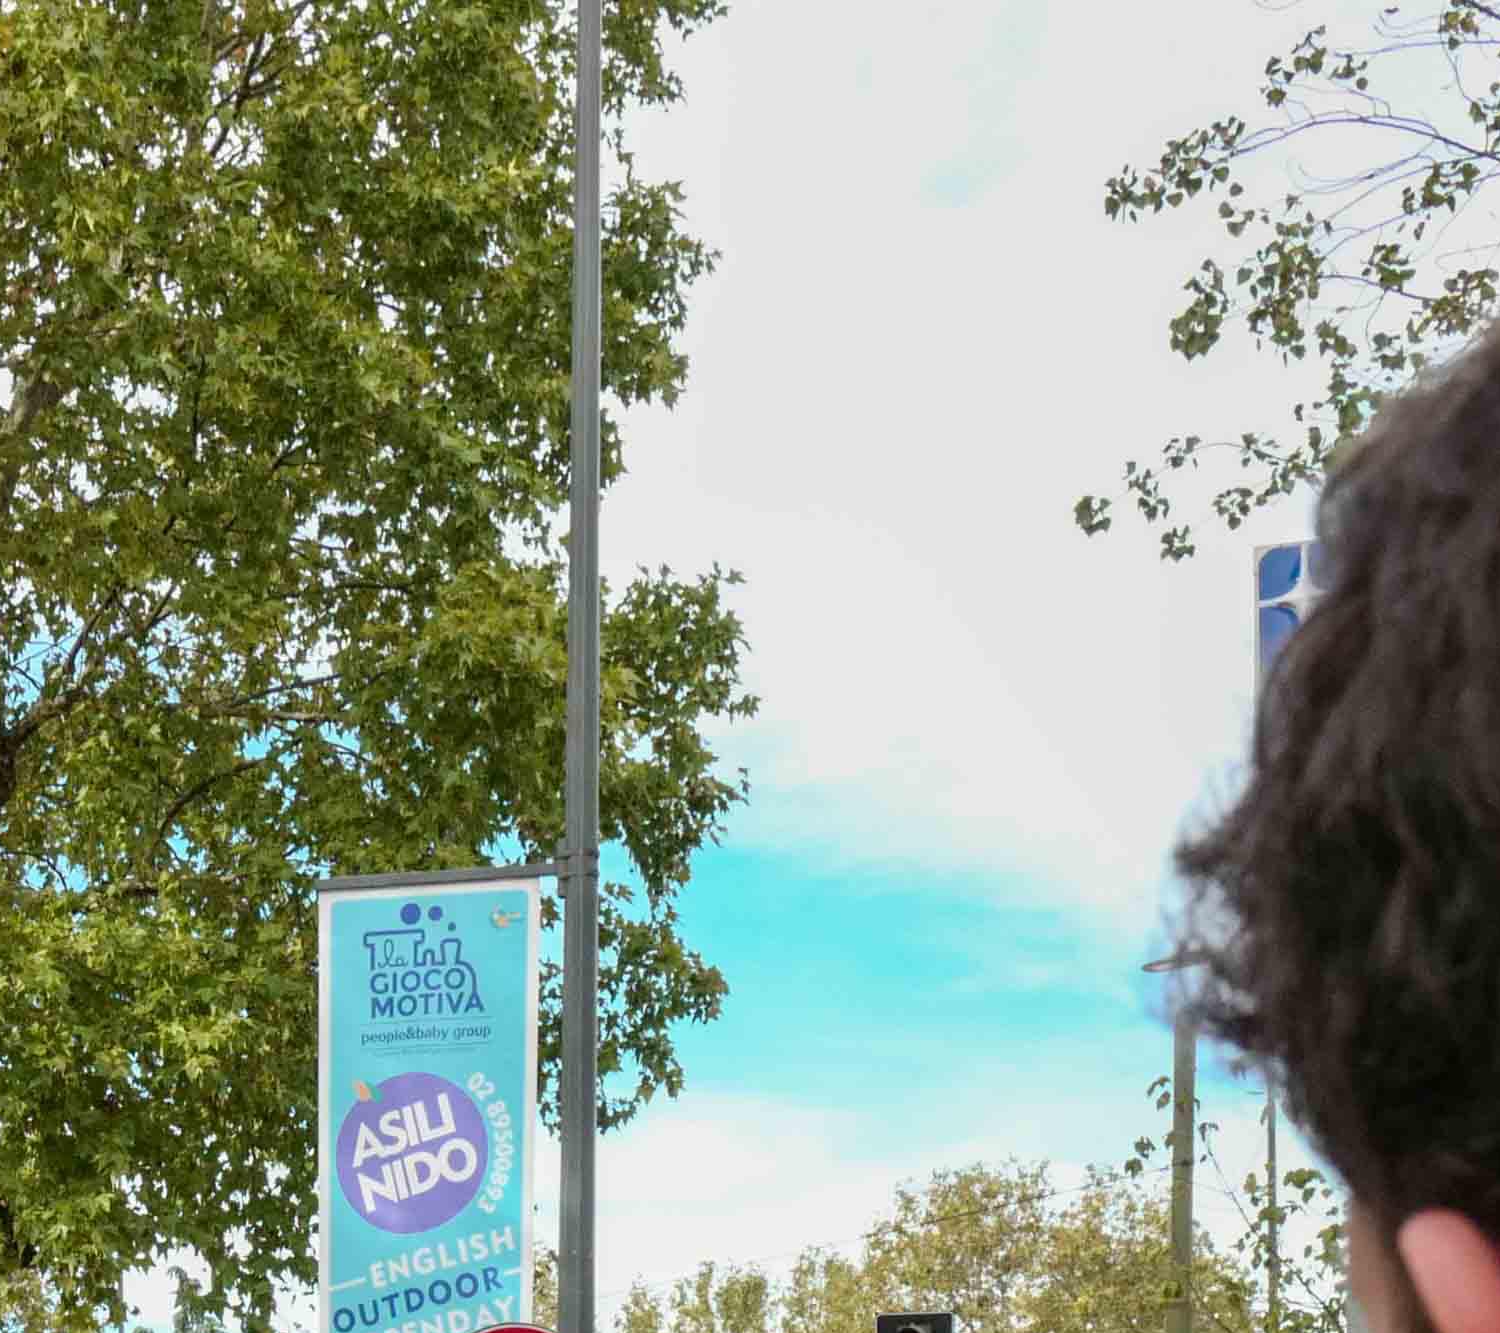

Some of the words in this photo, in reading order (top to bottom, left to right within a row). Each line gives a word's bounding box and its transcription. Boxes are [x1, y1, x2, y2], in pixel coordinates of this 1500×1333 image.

[378, 939, 408, 968] la
[370, 968, 465, 994] GIOCO
[371, 992, 485, 1018] MOTIVA
[361, 1025, 448, 1045] people&baby
[453, 1024, 490, 1040] group
[352, 1092, 457, 1168] ASILI
[357, 1137, 477, 1215] NIDO
[369, 1226, 516, 1288] ENGLISH
[333, 1266, 503, 1333] OUTDOOR
